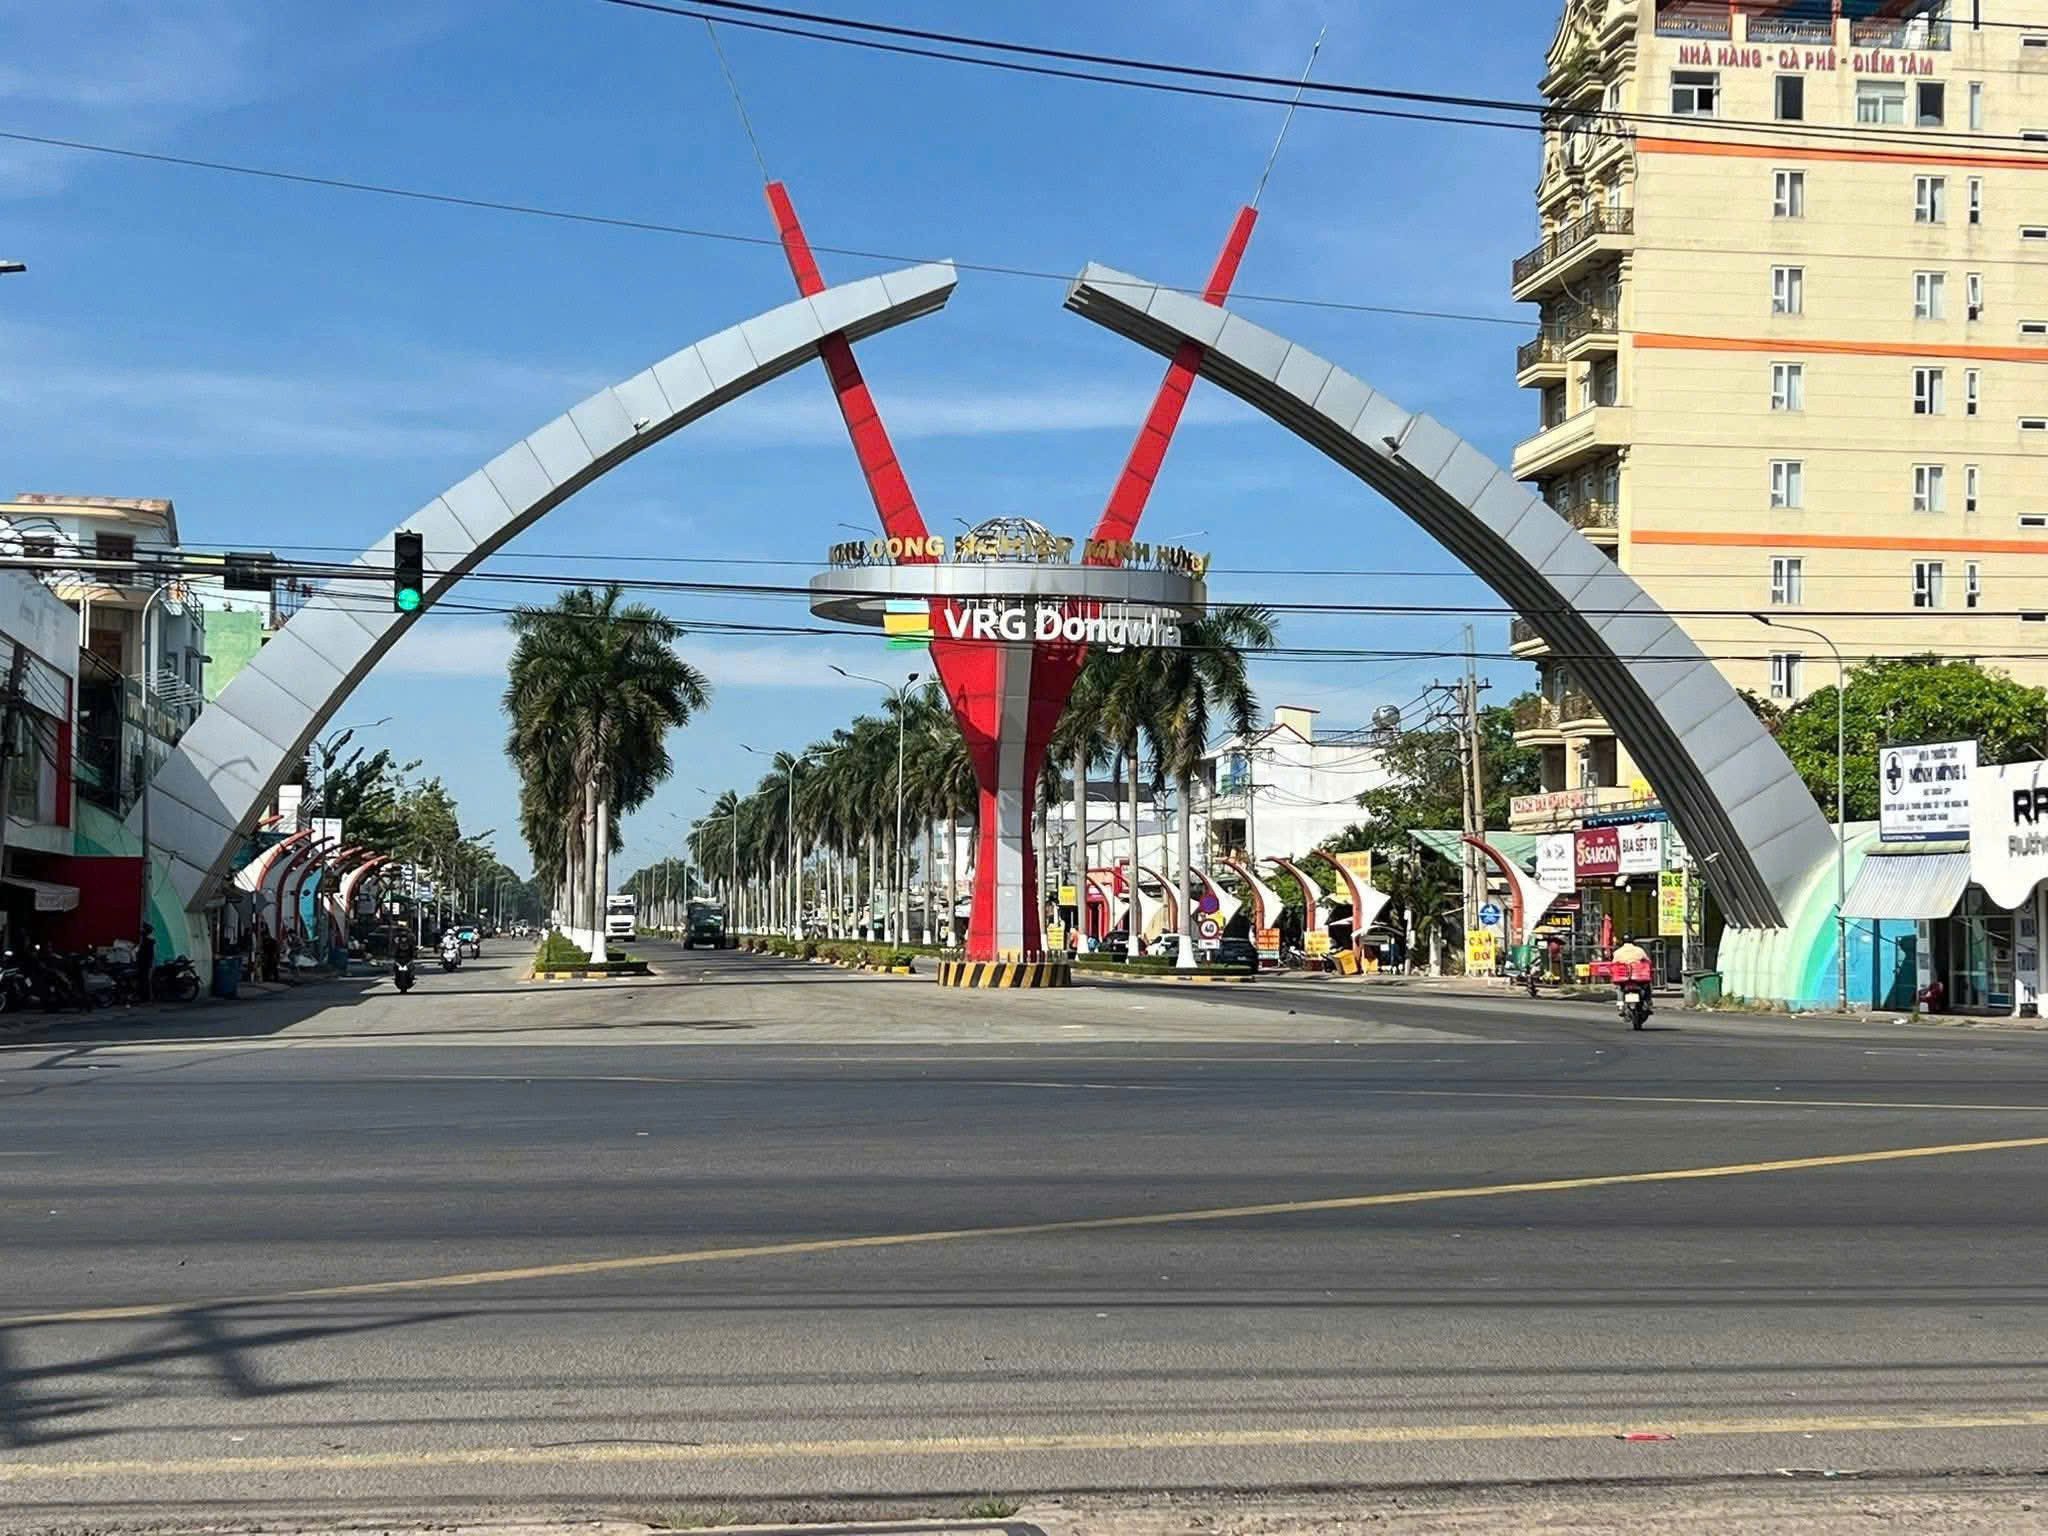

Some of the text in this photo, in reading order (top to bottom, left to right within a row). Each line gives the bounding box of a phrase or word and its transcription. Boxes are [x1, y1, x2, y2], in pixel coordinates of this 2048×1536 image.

[1680, 42, 1712, 65] NHÀ
[1718, 45, 1761, 68] HÀNG
[1900, 52, 1934, 76] TÂM
[943, 605, 1182, 653] VRG Dongwha
